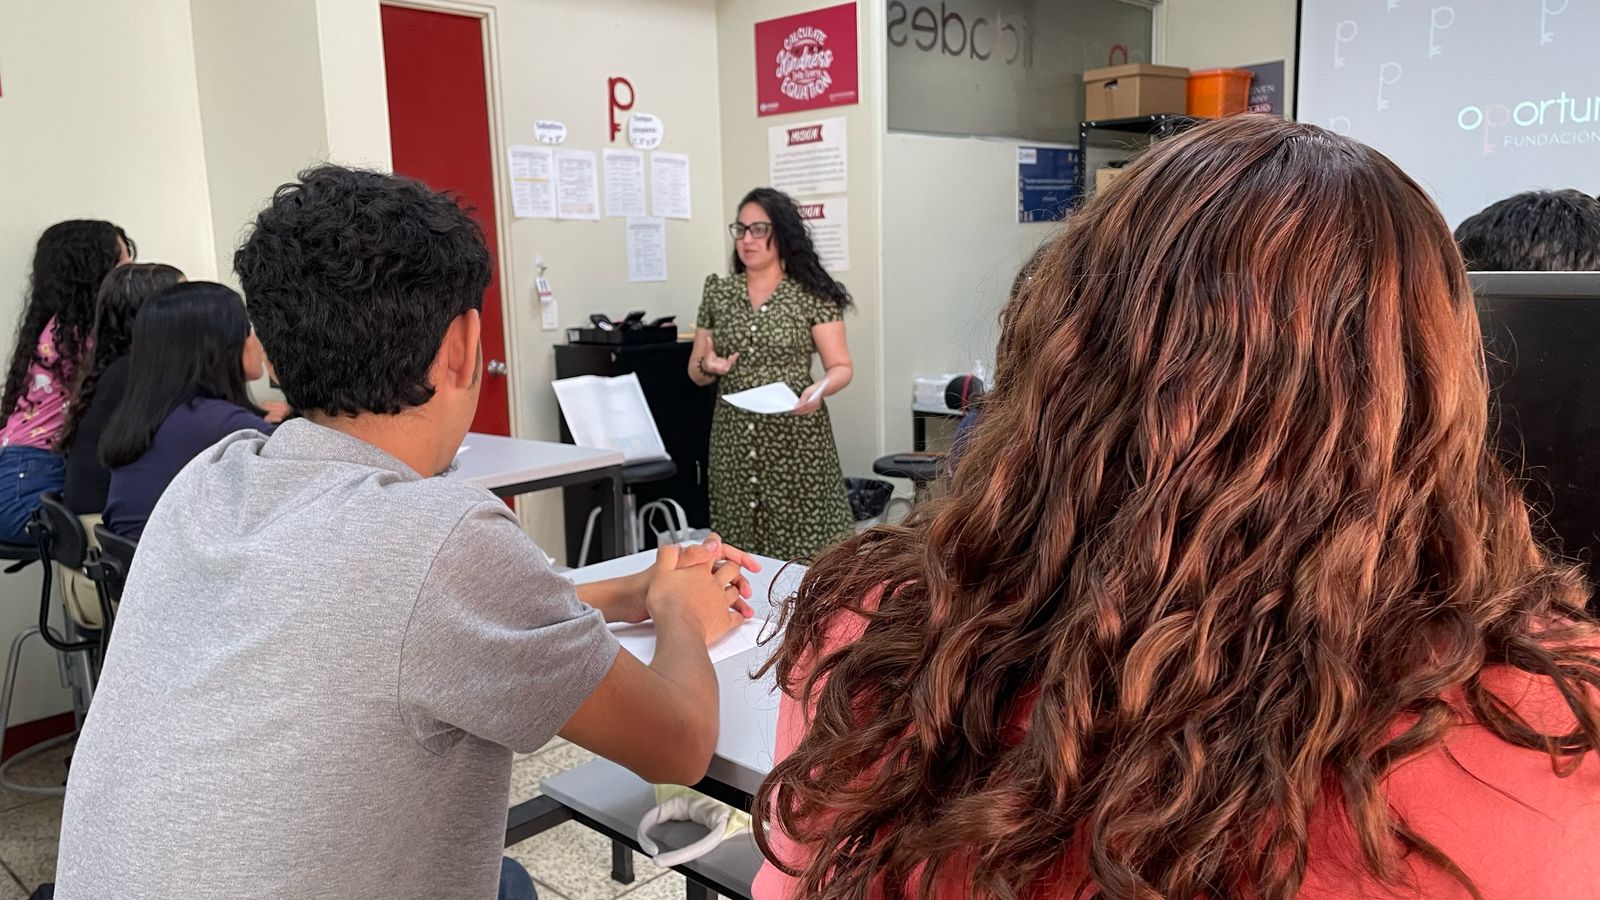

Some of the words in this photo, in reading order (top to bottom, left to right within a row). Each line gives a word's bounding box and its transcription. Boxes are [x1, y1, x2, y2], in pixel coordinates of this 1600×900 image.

[784, 26, 827, 50] CALCULATE
[776, 46, 834, 78] Kindness
[781, 70, 833, 100] EQUATION
